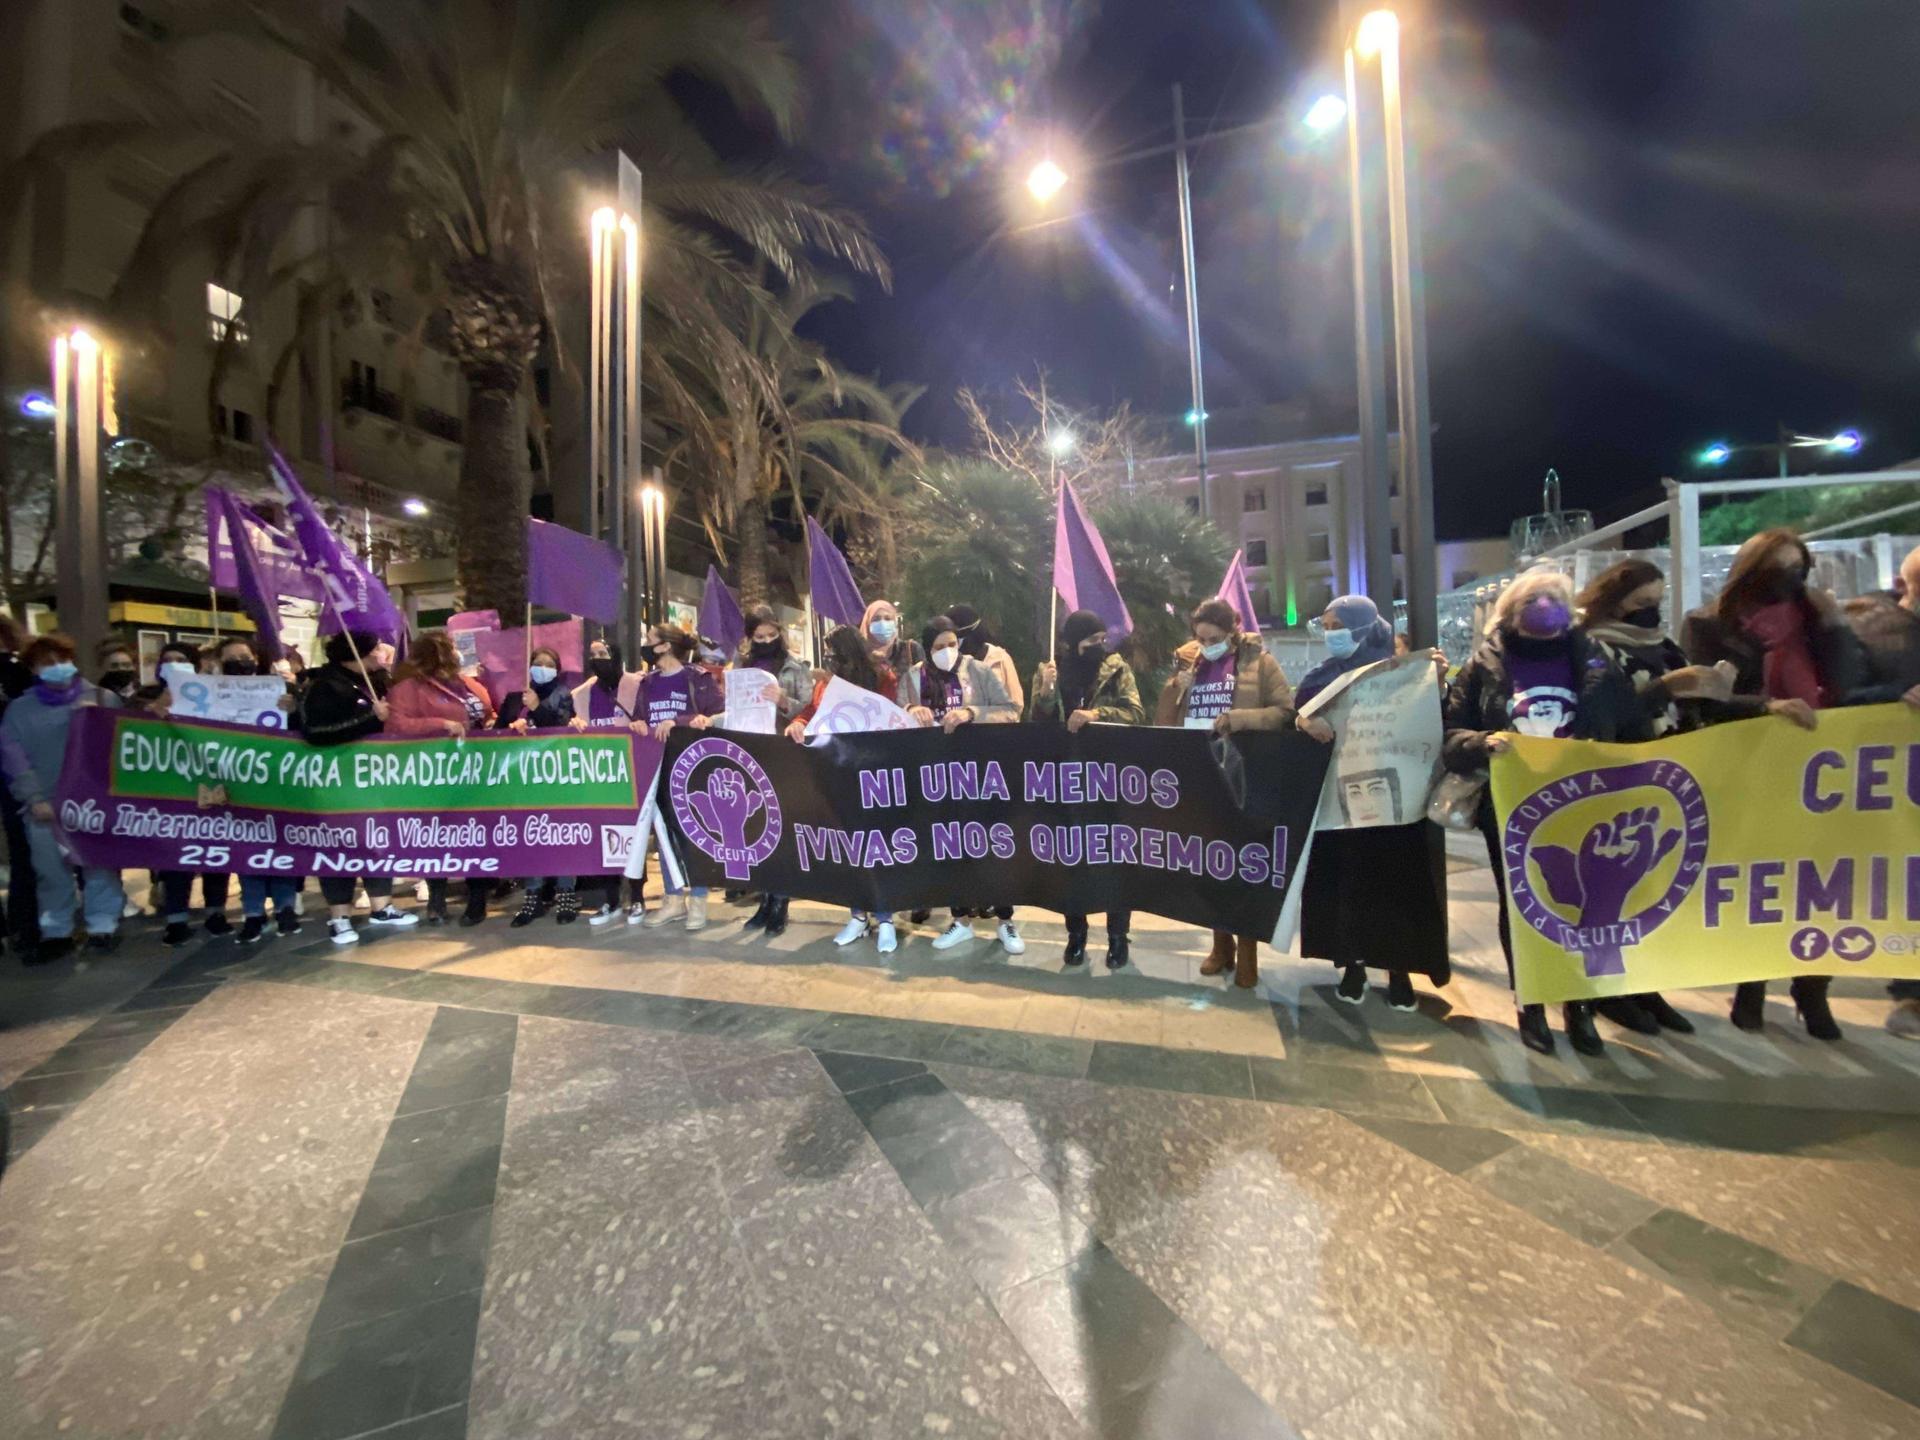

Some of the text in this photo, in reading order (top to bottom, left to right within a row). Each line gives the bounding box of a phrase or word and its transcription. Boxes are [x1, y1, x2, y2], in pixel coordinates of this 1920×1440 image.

[120, 731, 629, 788] EDUQUEMOS PARA ERRADICAR LA VIOLENCIA
[859, 761, 1179, 809] NI UNA MENOS
[1803, 744, 1920, 814] CE
[60, 799, 592, 848] Día Internacional contra la Violencia de Género
[672, 743, 708, 846] PLATAFORMA
[726, 743, 780, 850] FEMINISTA
[178, 845, 499, 873] 25 de Noviembre
[717, 848, 756, 862] CEUTA
[793, 821, 1288, 889] ¡VIVAS NOS QUEREMOS!
[1506, 772, 1607, 931] PLATAFORMA
[1652, 762, 1707, 913] FEMINISTA
[1565, 924, 1636, 949] CEUTA
